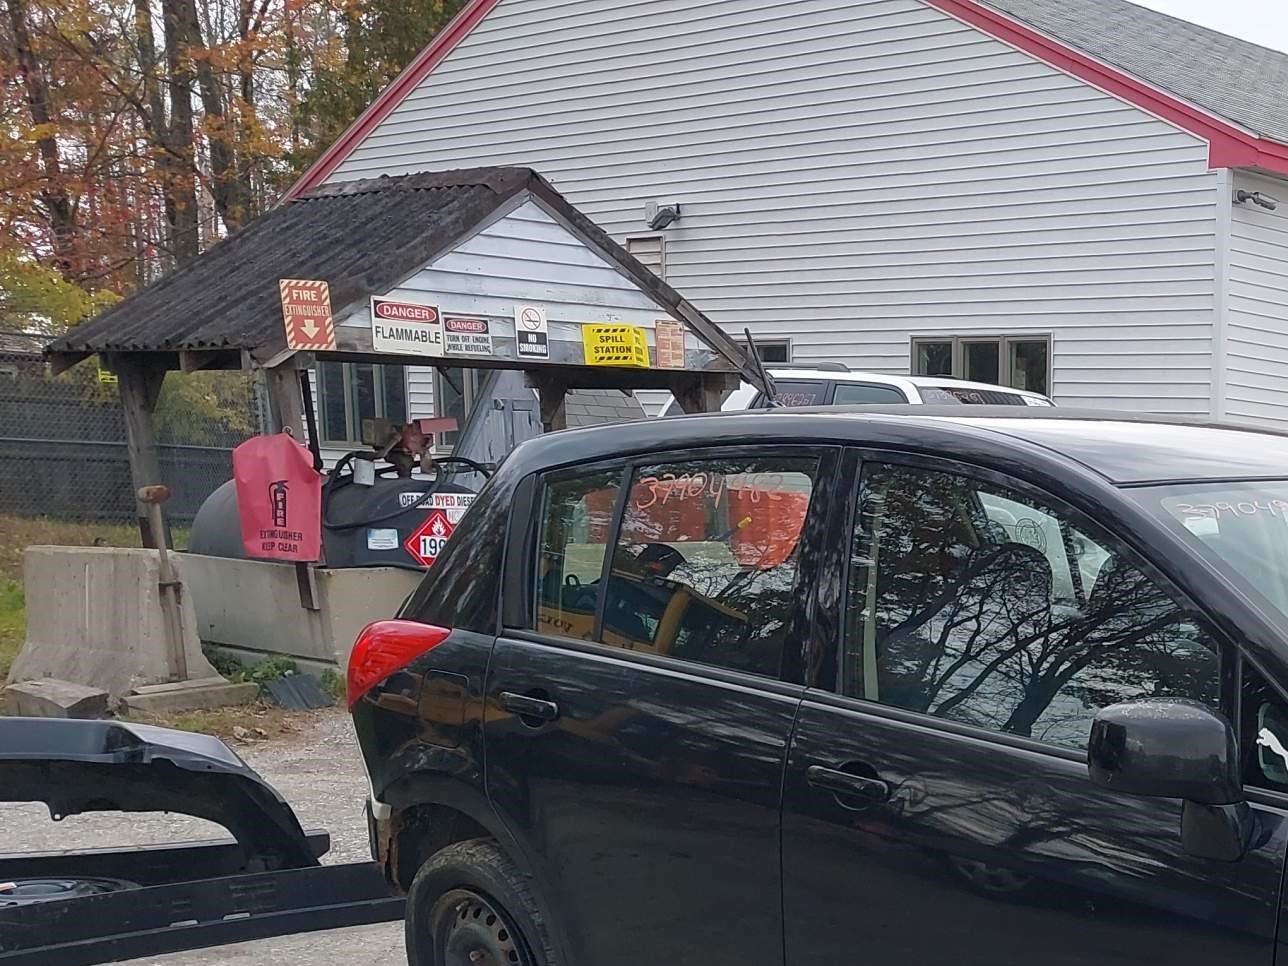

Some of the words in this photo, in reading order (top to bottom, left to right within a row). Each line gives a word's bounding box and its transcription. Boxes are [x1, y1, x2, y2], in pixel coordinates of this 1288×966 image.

[292, 289, 319, 301] FIRE
[284, 304, 330, 316] EXTINGUISHER
[383, 305, 430, 320] DANGER
[450, 321, 483, 331] DANGER
[375, 326, 440, 344] FLAMMABLE
[527, 333, 537, 343] NO
[599, 335, 625, 343] SPILL
[519, 343, 547, 353] SMOKING
[593, 345, 632, 354] STATION
[434, 495, 455, 507] DYED
[276, 493, 285, 526] FIRE
[277, 542, 298, 553] CLEAR
